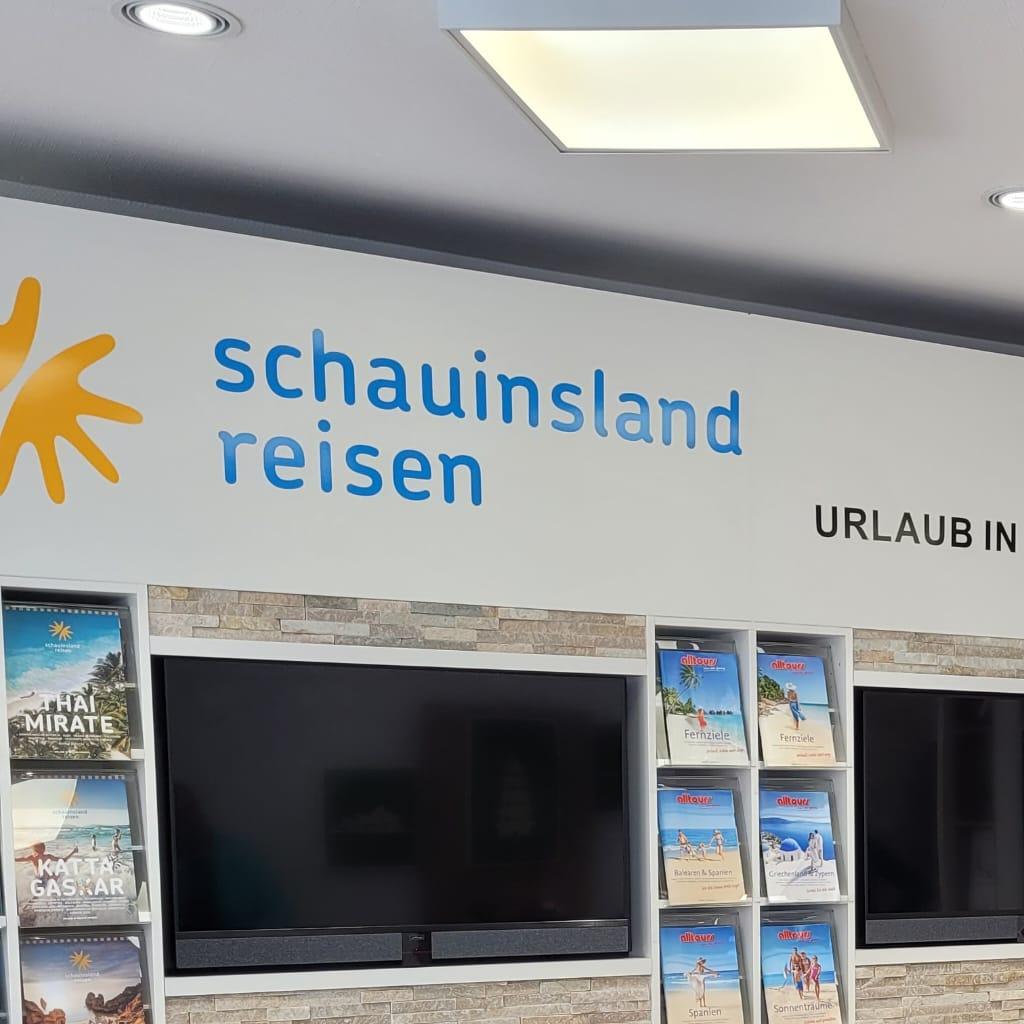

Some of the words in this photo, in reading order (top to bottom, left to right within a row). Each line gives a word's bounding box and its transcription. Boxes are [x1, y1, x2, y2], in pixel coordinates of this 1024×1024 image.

[214, 329, 742, 455] schauinsland
[218, 419, 482, 506] reisen
[815, 504, 973, 548] URLAUB
[984, 520, 1017, 553] IN
[25, 714, 114, 733] MIRATE
[684, 729, 731, 741] Fernziele
[39, 858, 114, 876] KATTA
[688, 1008, 722, 1019] Spanien
